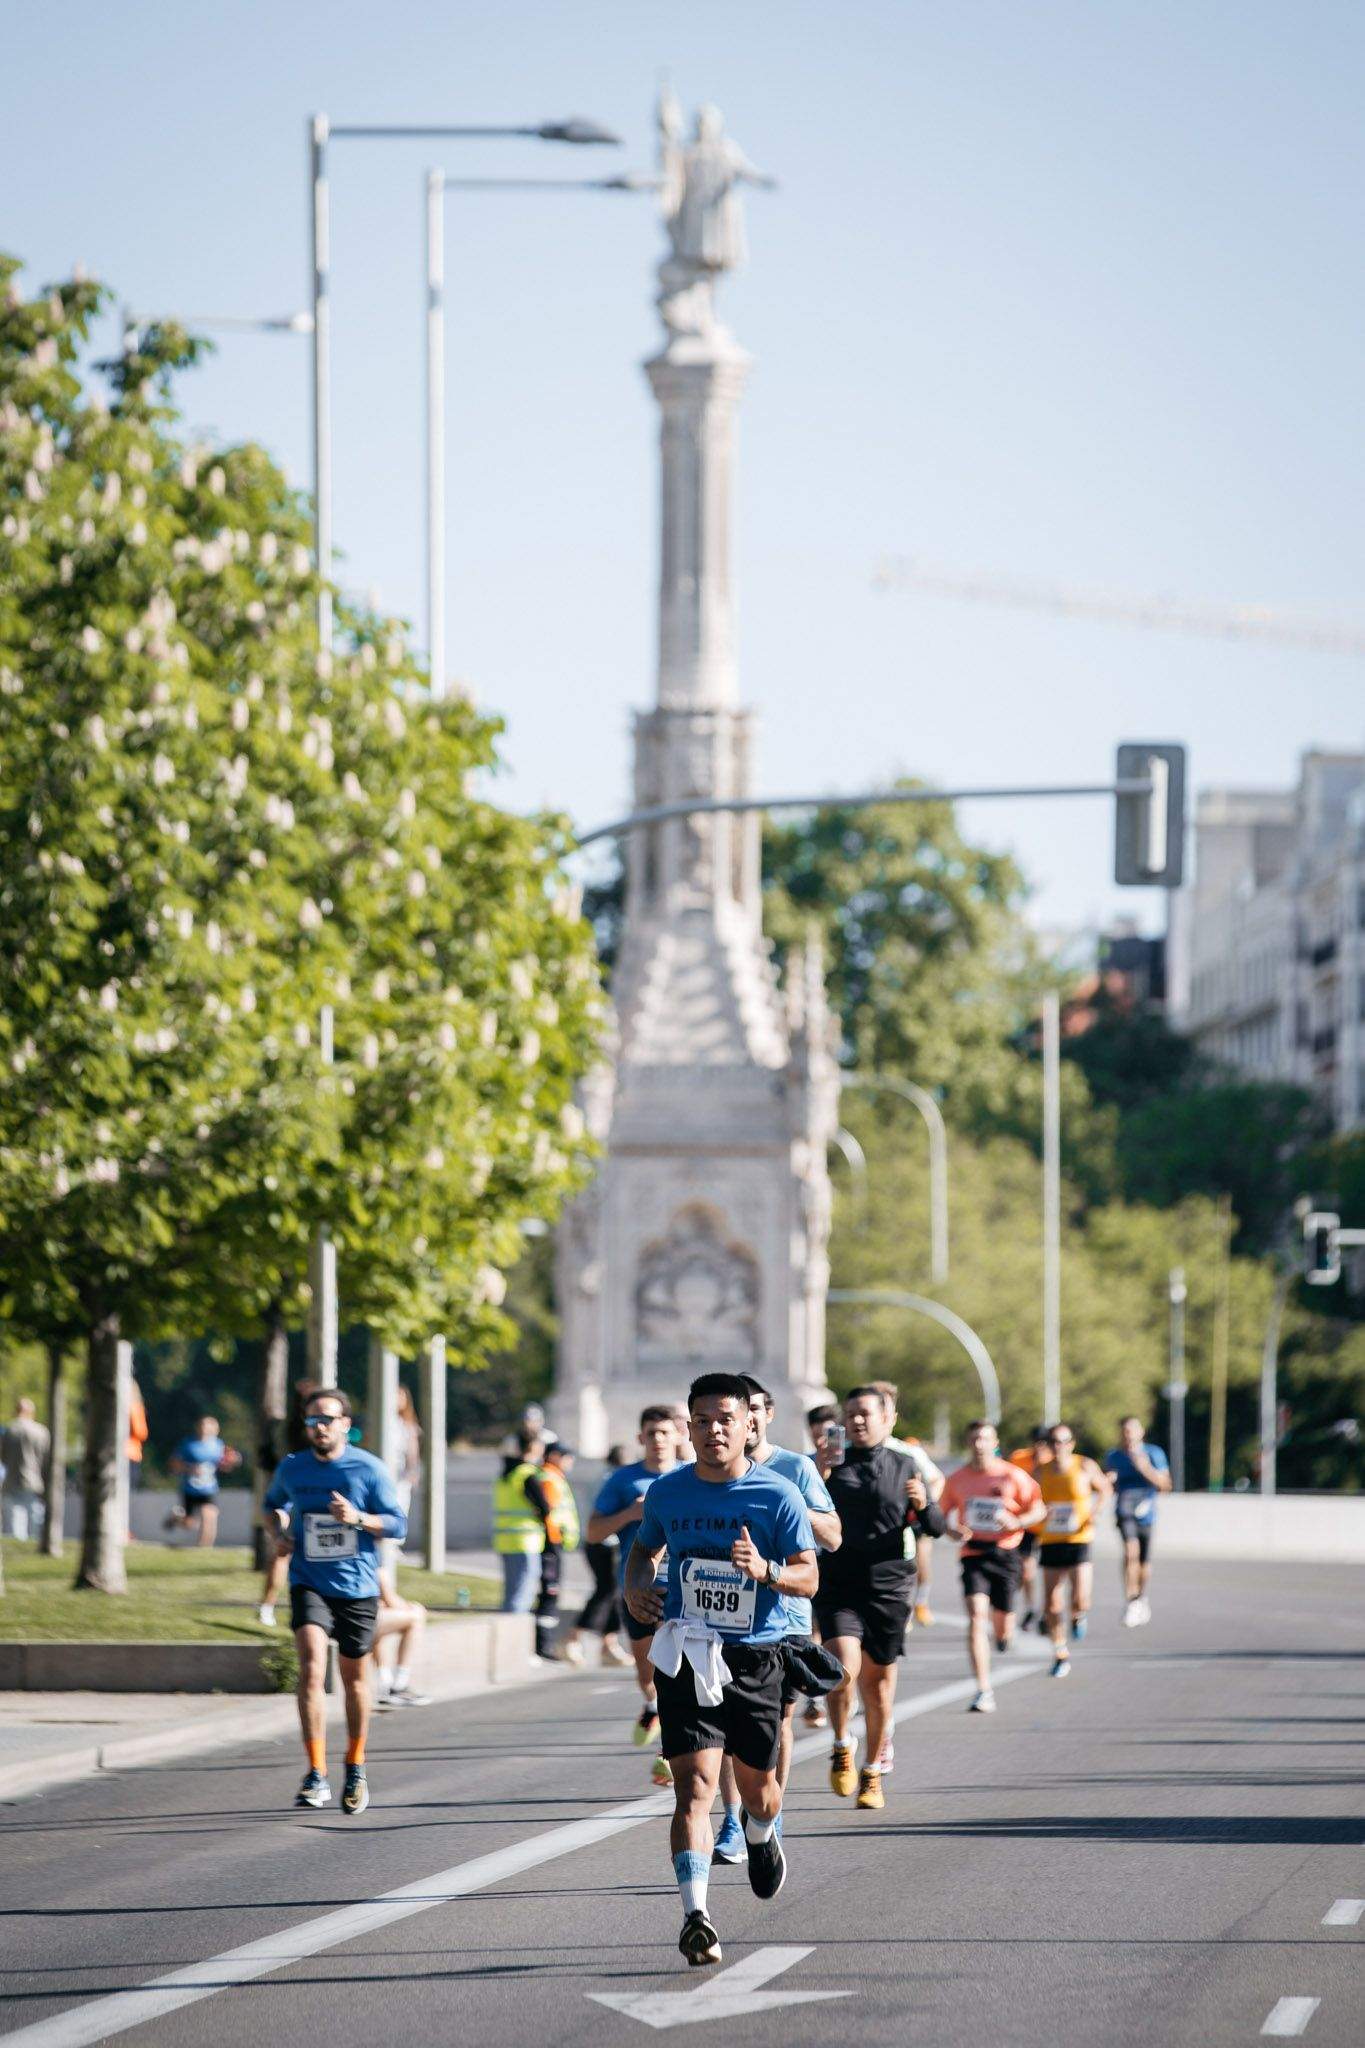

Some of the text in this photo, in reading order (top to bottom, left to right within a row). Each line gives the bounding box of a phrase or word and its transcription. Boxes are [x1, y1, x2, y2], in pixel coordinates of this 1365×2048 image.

[704, 1569, 742, 1579] BOMBEROS
[699, 1581, 740, 1591] DECIMAS
[694, 1587, 740, 1613] 1639
